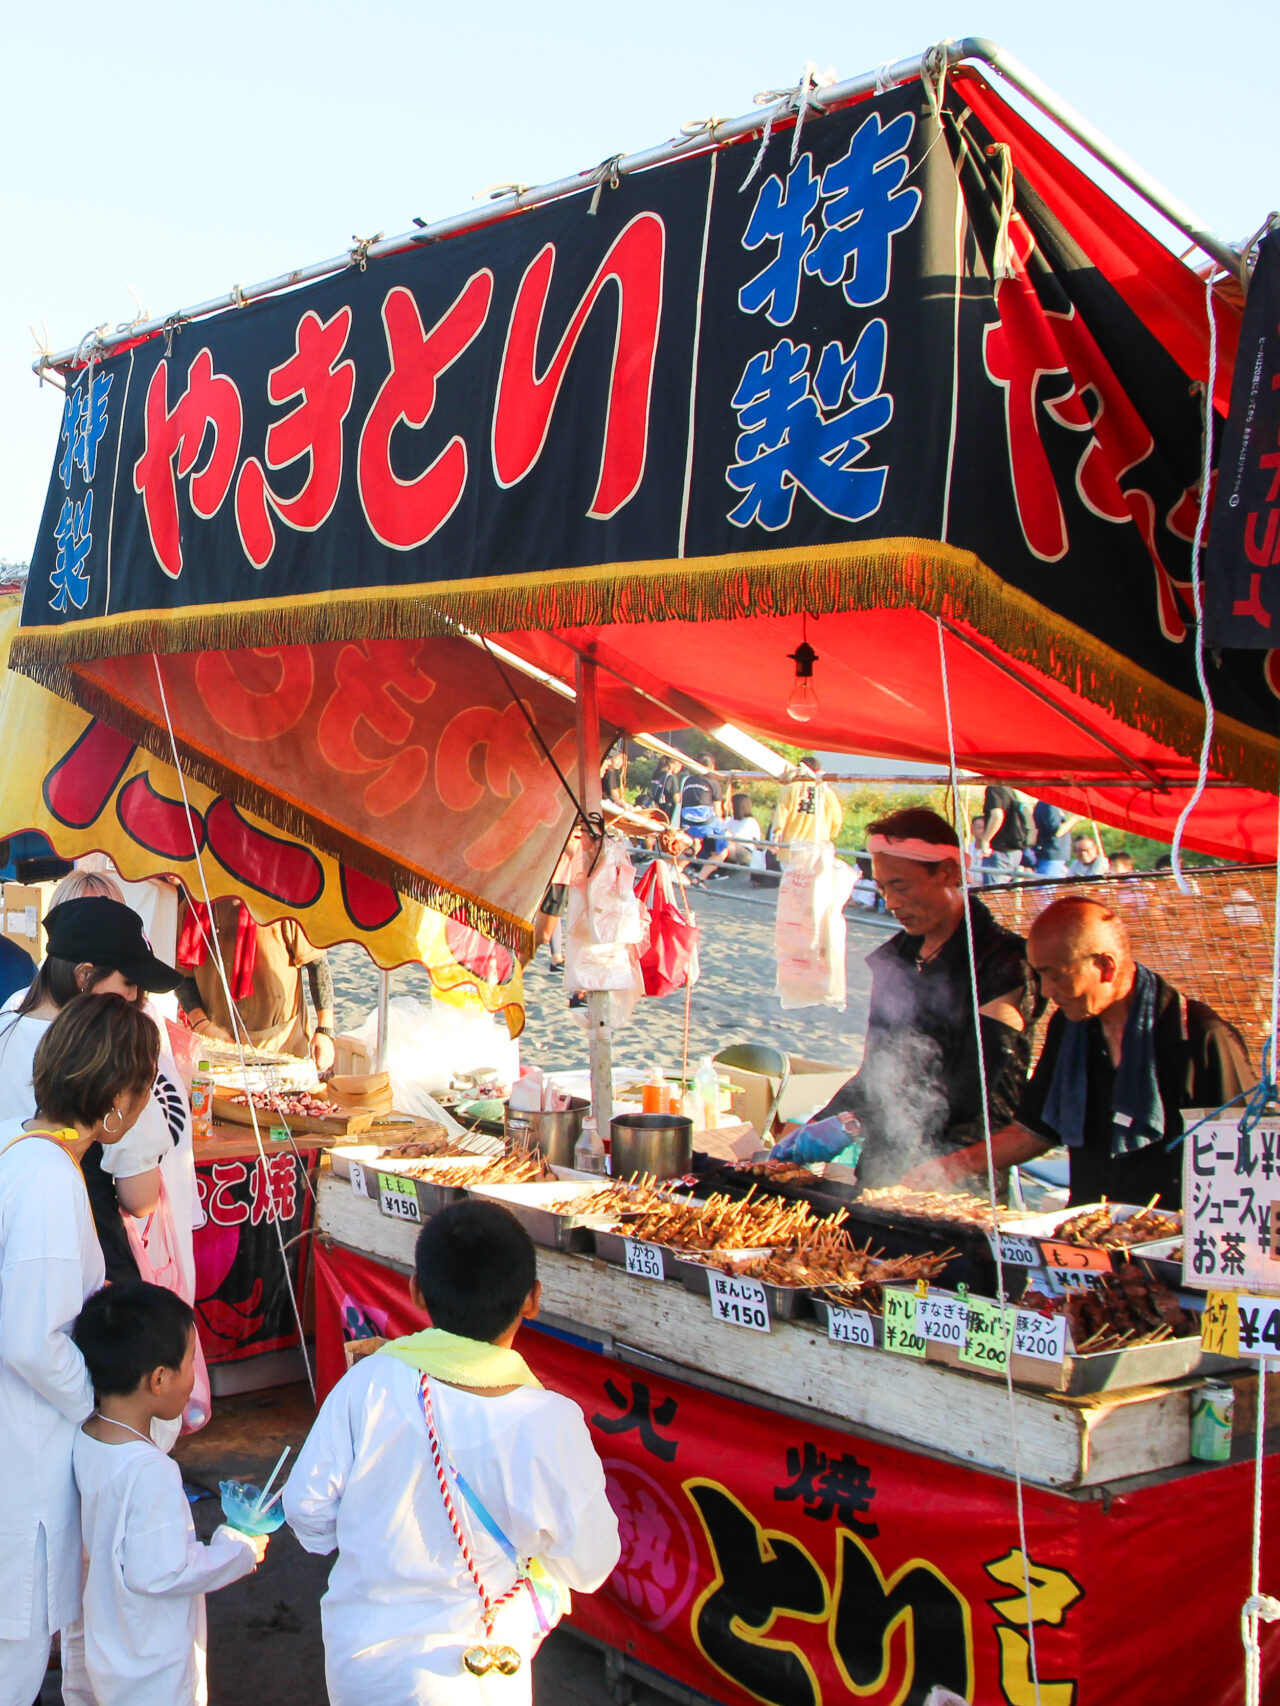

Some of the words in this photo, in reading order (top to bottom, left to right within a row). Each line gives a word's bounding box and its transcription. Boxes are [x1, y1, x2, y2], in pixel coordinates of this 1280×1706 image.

[726, 110, 923, 532] 特製
[133, 210, 667, 580] やきとり
[47, 369, 115, 614] 特製
[1192, 1131, 1259, 1178] ビール
[193, 1151, 297, 1231] こ焼
[1192, 1181, 1257, 1225] ジュース
[385, 1196, 418, 1217] ¥150
[632, 1244, 655, 1260] かわ
[1000, 1247, 1033, 1263] ¥200
[1052, 1249, 1089, 1268] もつ
[1192, 1230, 1247, 1276] お茶
[628, 1257, 660, 1277] ¥150
[1054, 1270, 1102, 1291] ¥15
[718, 1300, 766, 1328] ¥150
[919, 1301, 968, 1321] すなぎも
[832, 1322, 870, 1344] ¥150
[886, 1325, 926, 1352] ¥200
[924, 1319, 961, 1340] ¥200
[1016, 1315, 1057, 1335] 豚タン
[964, 1337, 1007, 1364] ¥200
[1016, 1335, 1058, 1357] ¥200
[591, 1378, 679, 1462] 火
[773, 1441, 880, 1540] 焼
[681, 1477, 975, 1706] とり
